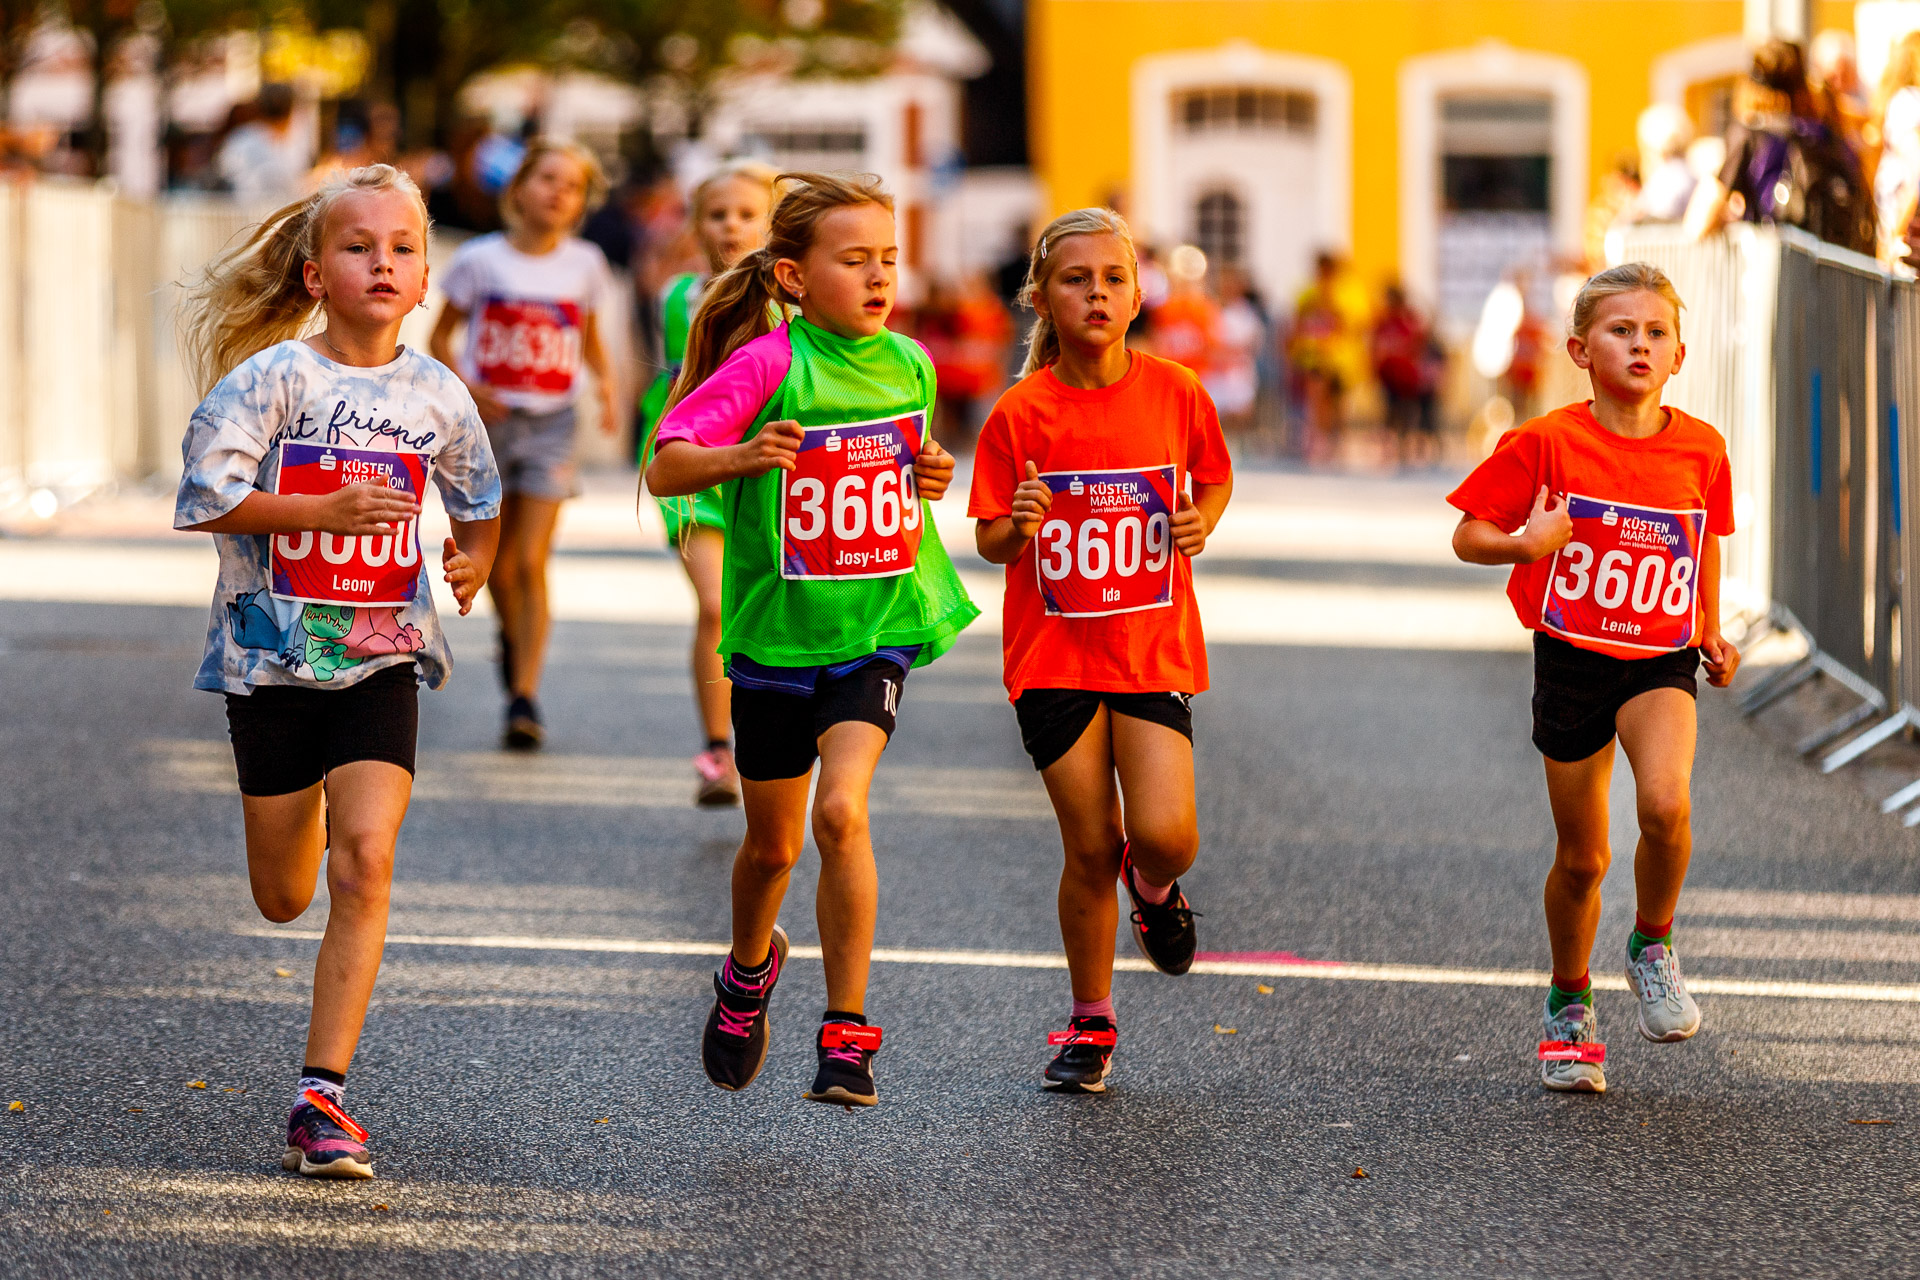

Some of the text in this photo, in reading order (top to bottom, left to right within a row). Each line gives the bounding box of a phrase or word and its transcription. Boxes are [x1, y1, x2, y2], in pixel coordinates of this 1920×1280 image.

[847, 432, 893, 450] KÜSTEN
[847, 443, 902, 462] MARATHON
[342, 458, 394, 476] KÜSTEN
[1089, 482, 1138, 495] KÜSTEN
[788, 464, 920, 541] 3669
[1090, 492, 1149, 507] MARATHON
[1622, 516, 1670, 533] KÜSTEN
[1041, 512, 1170, 580] 3609
[1620, 529, 1680, 546] MARATHON
[835, 548, 899, 568] Josy-Lee
[332, 574, 376, 596] Leony
[1554, 541, 1694, 616] 3608
[1102, 587, 1121, 603] Ida
[1601, 617, 1642, 636] Lenke
[882, 679, 898, 717] 10
